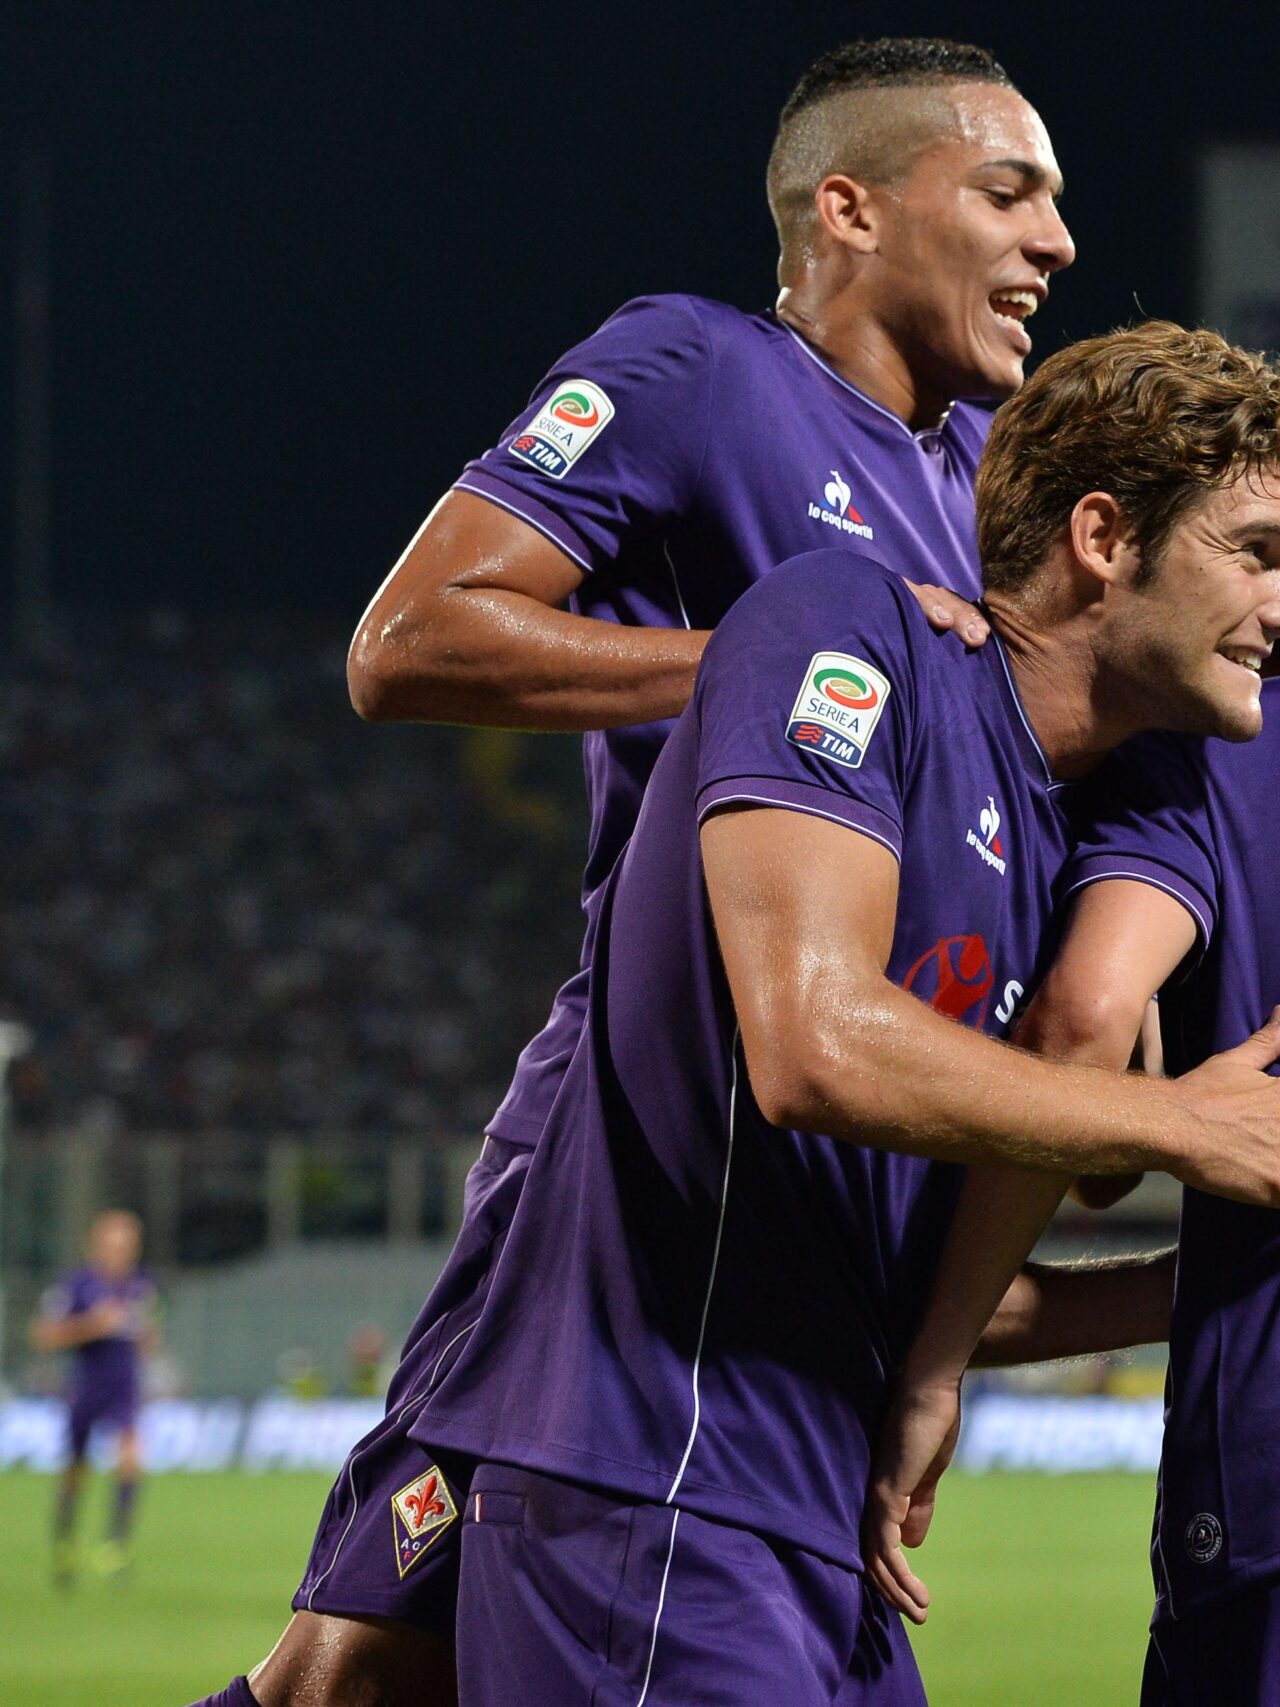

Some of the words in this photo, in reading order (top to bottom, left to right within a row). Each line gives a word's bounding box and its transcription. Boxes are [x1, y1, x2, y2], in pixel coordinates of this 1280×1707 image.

[560, 432, 574, 447] A
[529, 441, 562, 471] TIM
[807, 698, 850, 726] SERIE
[847, 717, 859, 733] A
[822, 733, 855, 760] TIM
